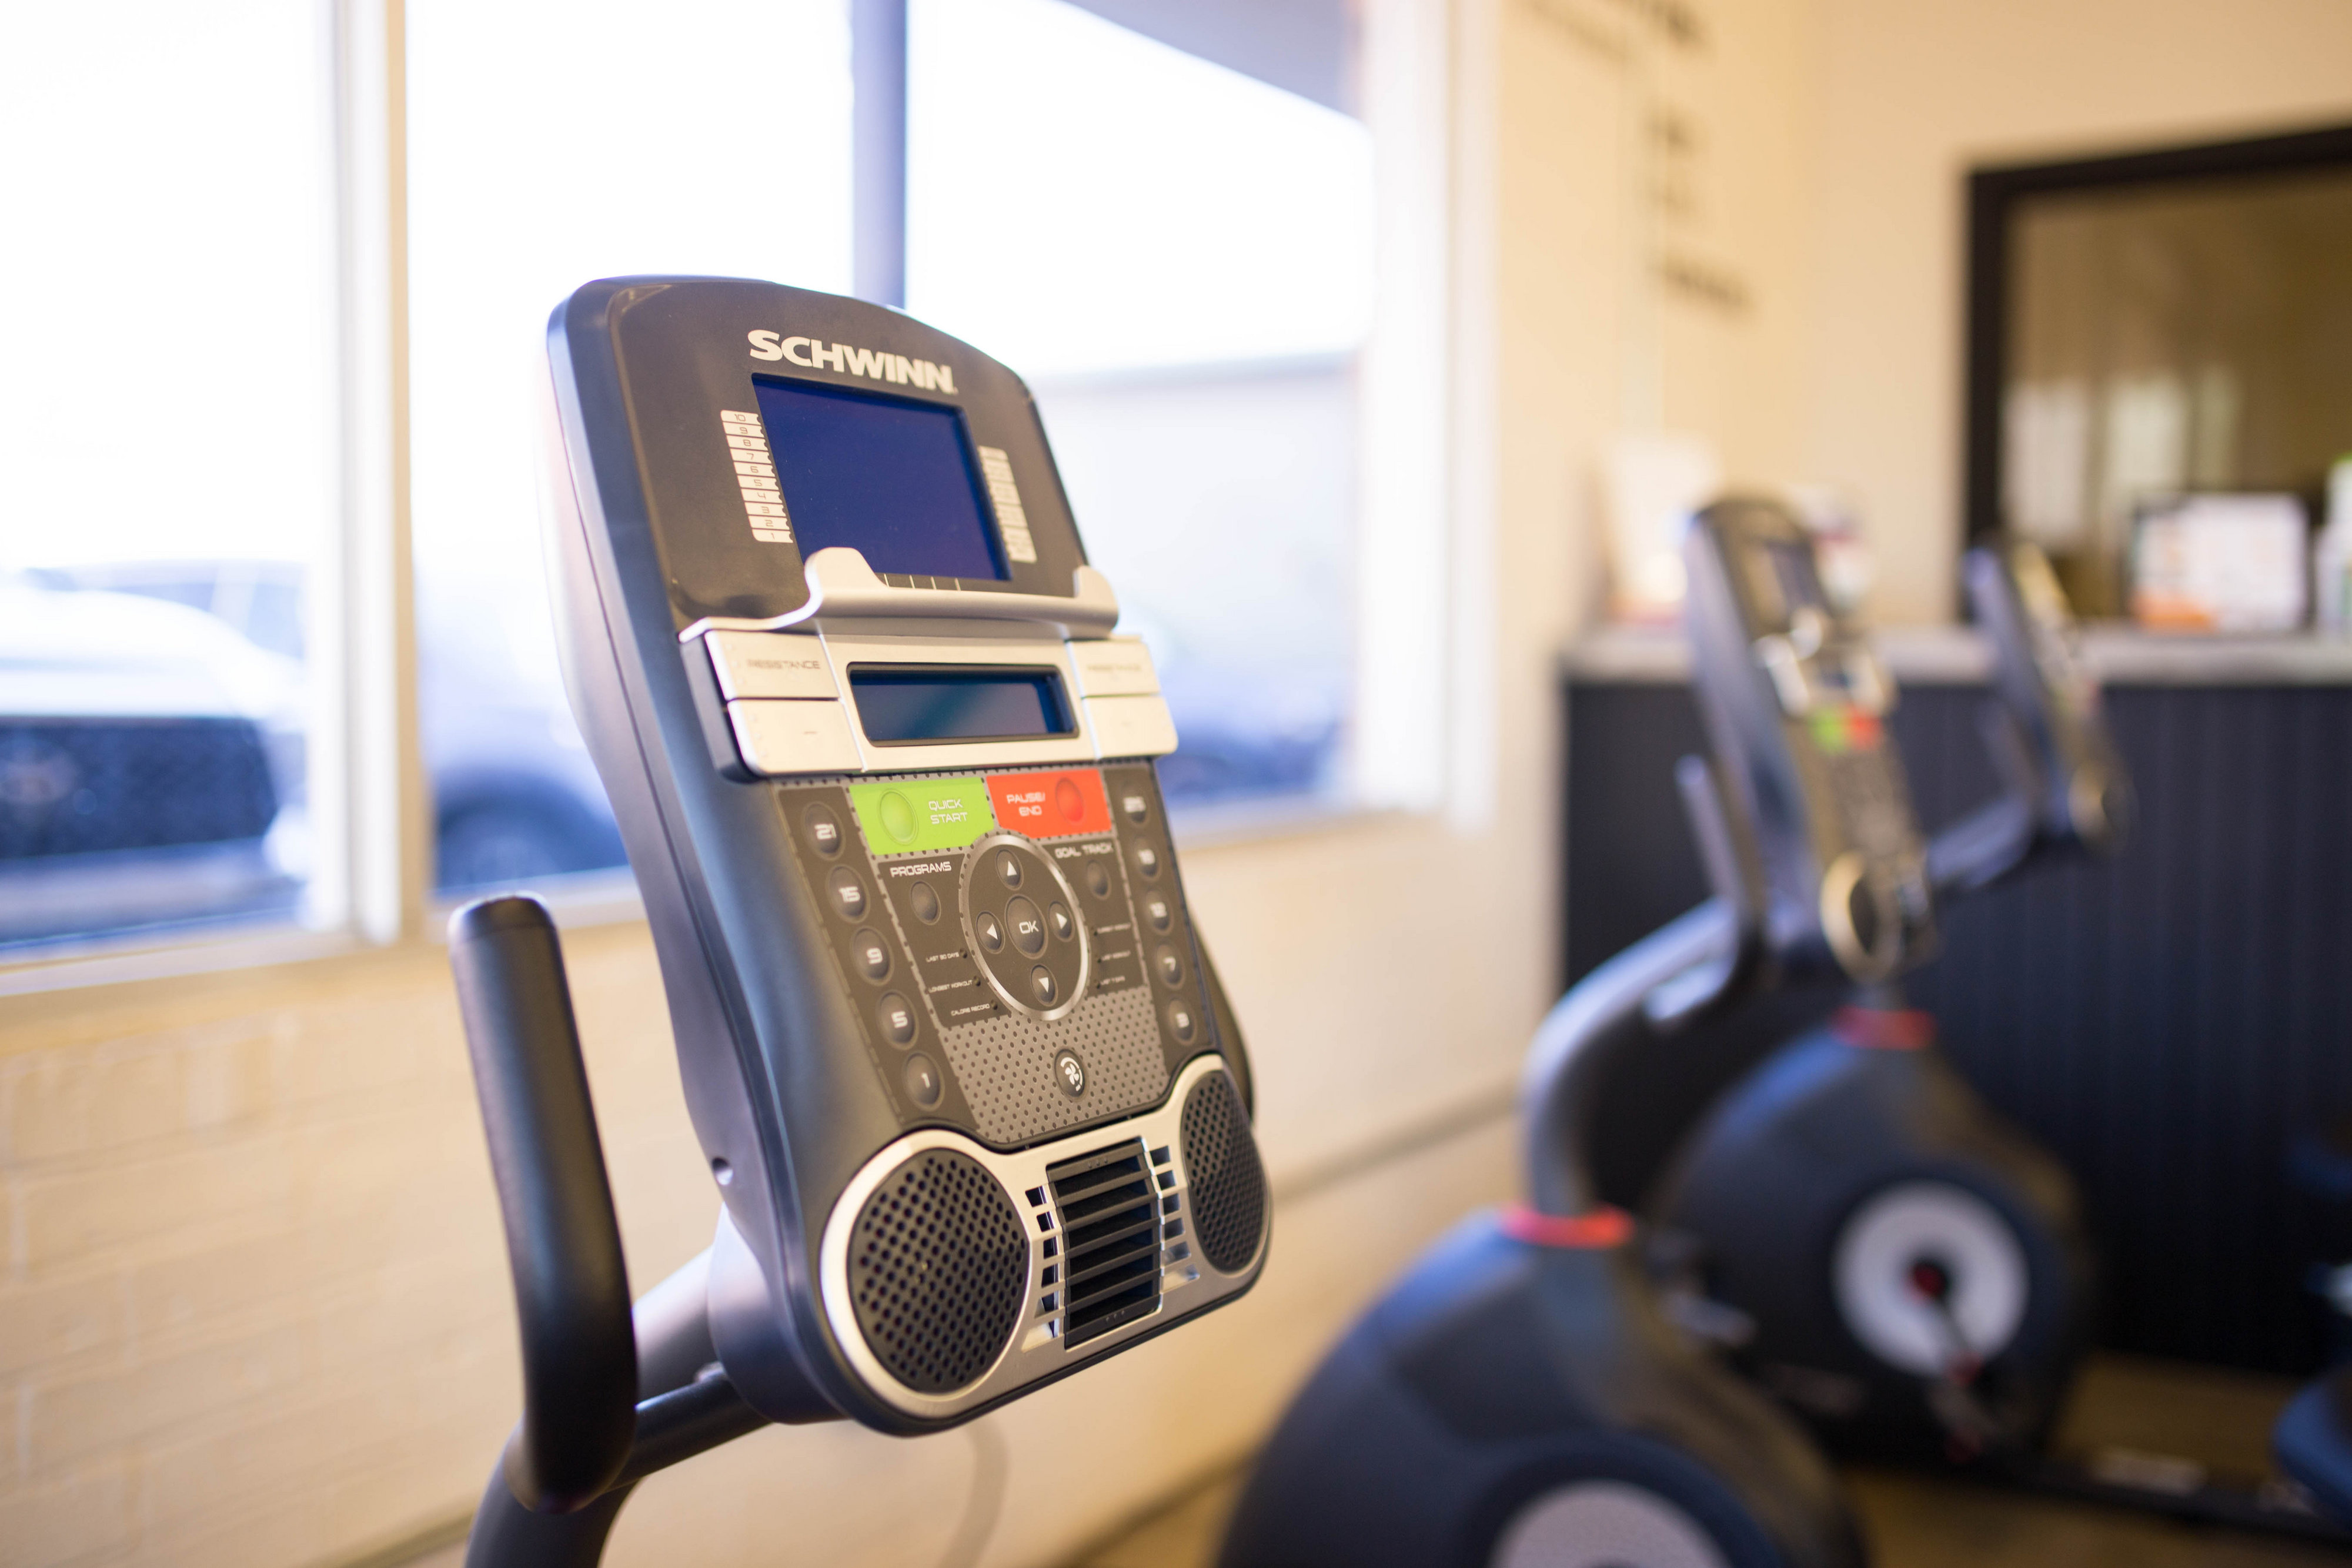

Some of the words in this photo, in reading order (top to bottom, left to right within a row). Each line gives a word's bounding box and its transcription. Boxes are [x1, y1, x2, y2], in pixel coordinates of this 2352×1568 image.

[747, 329, 954, 394] SCHWINN
[734, 414, 746, 422] 10
[928, 799, 963, 811] QUICK
[1018, 805, 1043, 817] END
[930, 812, 967, 824] START
[814, 823, 837, 840] 21
[1054, 847, 1081, 859] GOAL
[890, 861, 952, 877] PROGRAMS
[838, 886, 861, 902] 15
[1019, 921, 1039, 934] OK
[866, 948, 883, 964] 9
[891, 1011, 908, 1028] 5
[921, 1072, 930, 1088] 1
